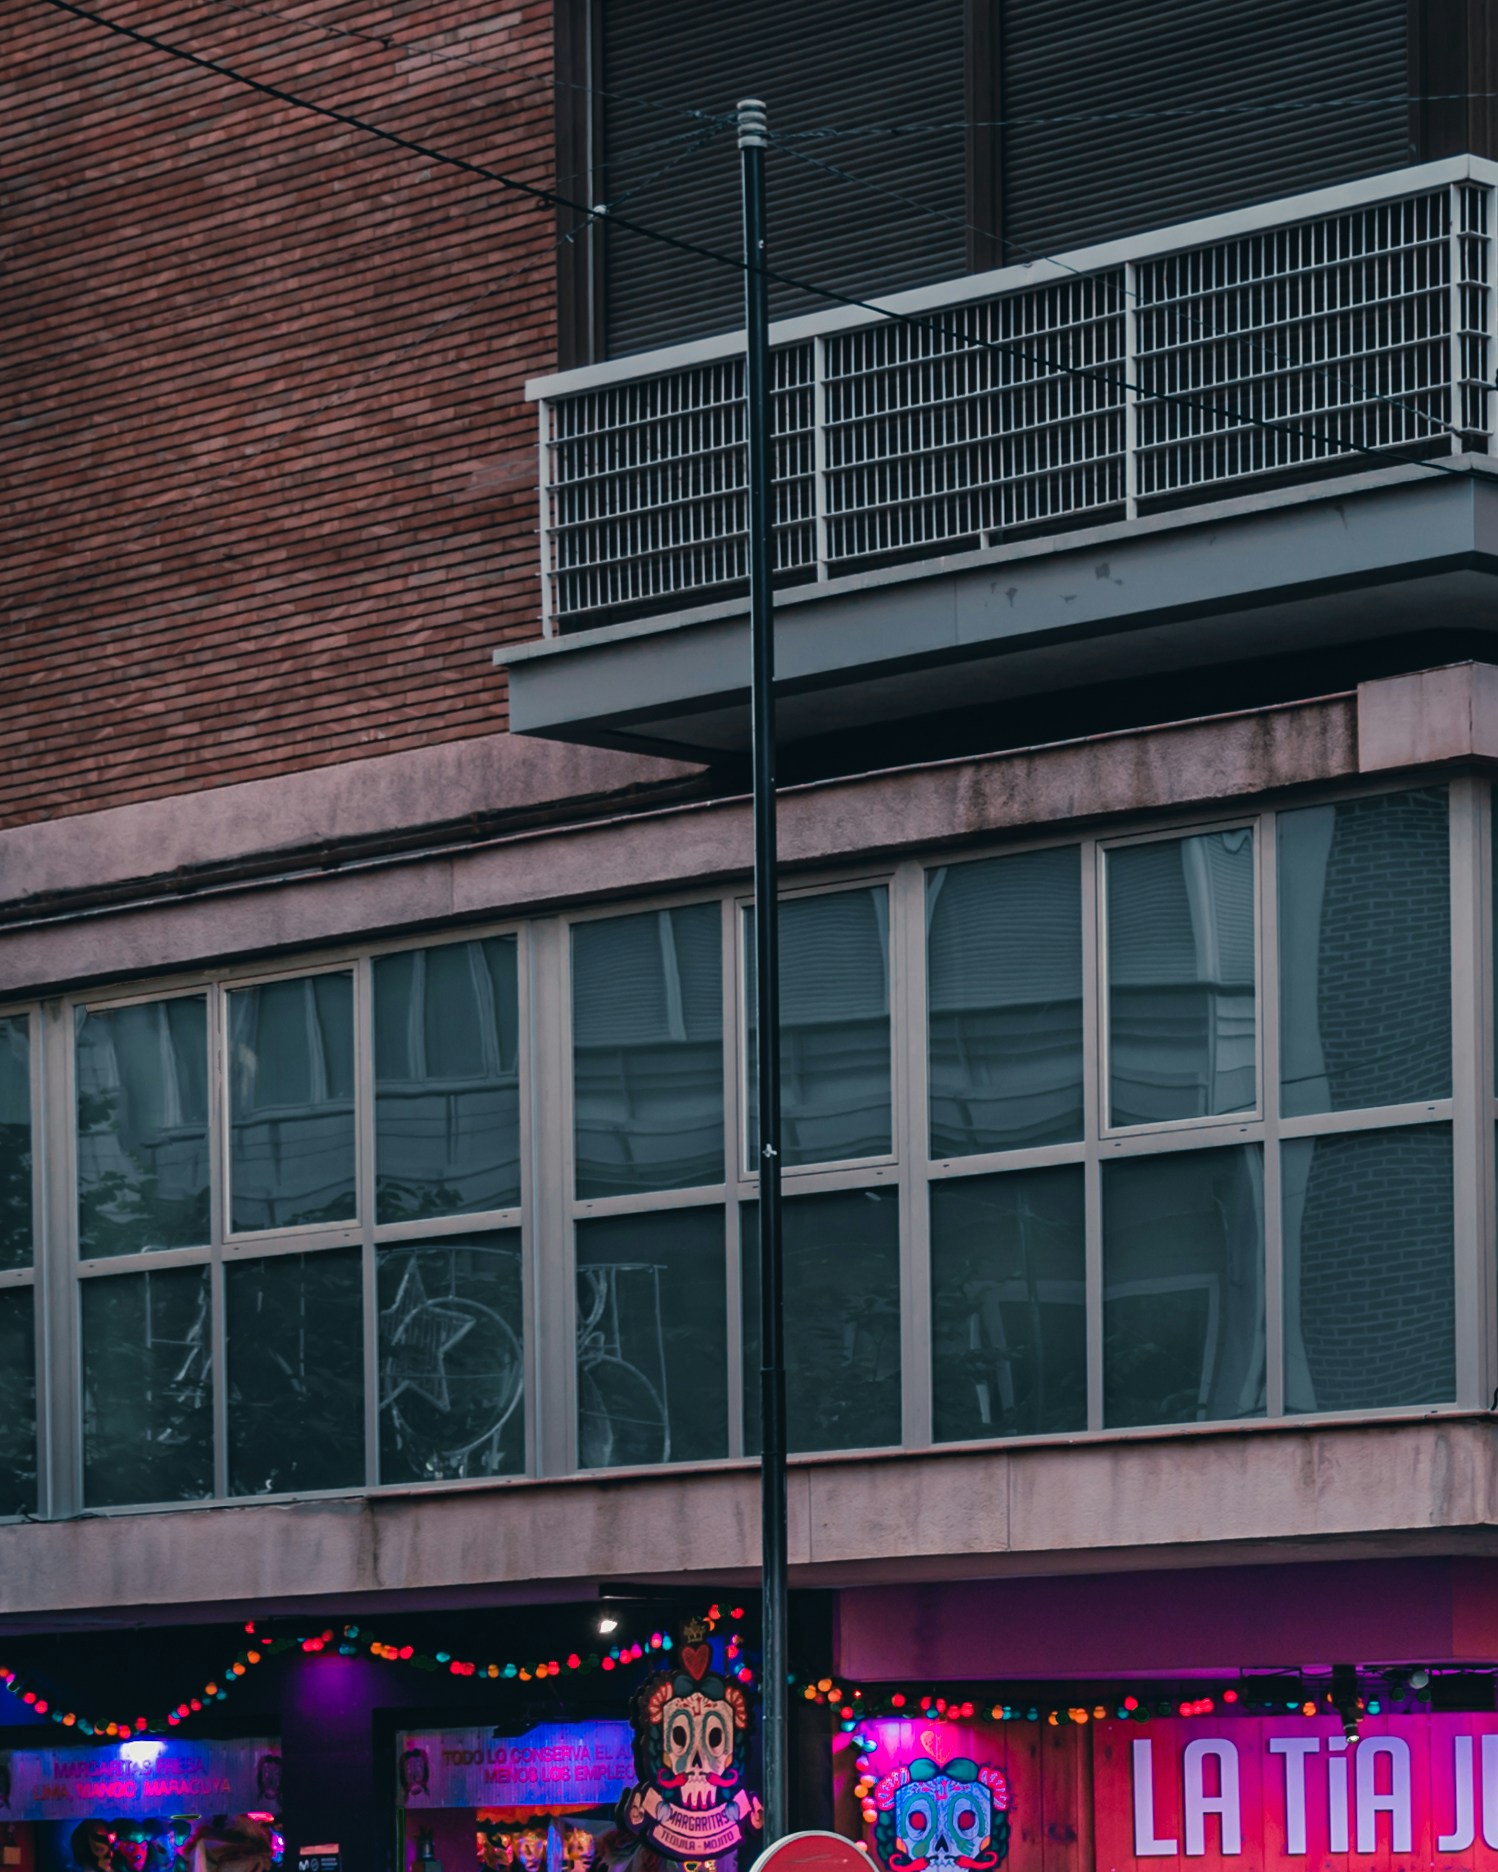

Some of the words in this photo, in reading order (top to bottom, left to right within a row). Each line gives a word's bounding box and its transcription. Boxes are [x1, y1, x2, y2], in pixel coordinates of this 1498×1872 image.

[443, 1750, 483, 1766] TODO
[488, 1749, 508, 1764] LO
[511, 1746, 591, 1763] CONSERVA
[595, 1745, 613, 1760] EL
[485, 1767, 538, 1784] MENOS
[541, 1765, 571, 1782] LOS
[575, 1764, 635, 1782] EMPLEO
[1132, 1738, 1242, 1857] LA
[669, 1810, 730, 1832] MARGARITAS
[660, 1829, 696, 1851] TEQUILA
[703, 1831, 735, 1851] MOJITO
